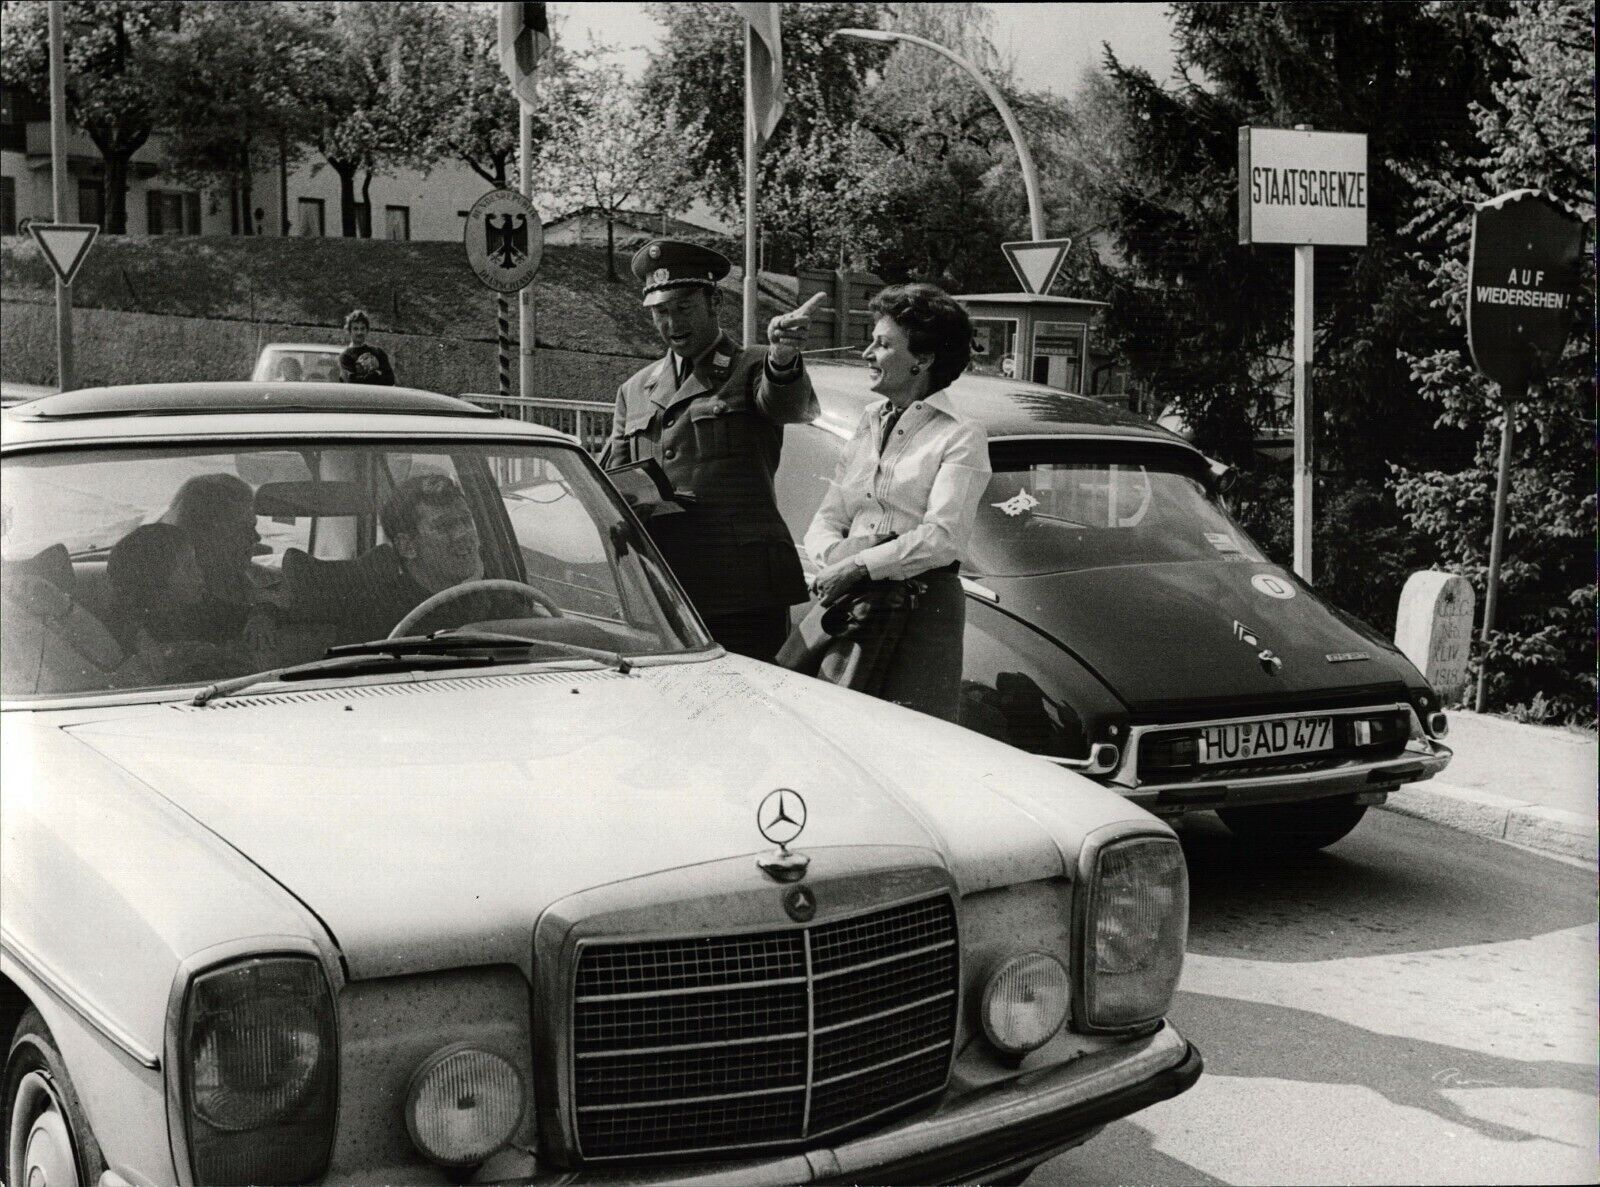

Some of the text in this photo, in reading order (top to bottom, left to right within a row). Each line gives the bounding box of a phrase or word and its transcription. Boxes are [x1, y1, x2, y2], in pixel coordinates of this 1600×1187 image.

[1252, 166, 1366, 208] STAATSGRENZE
[1507, 268, 1545, 287] AUF
[1262, 578, 1285, 594] D
[1293, 717, 1330, 750] 477
